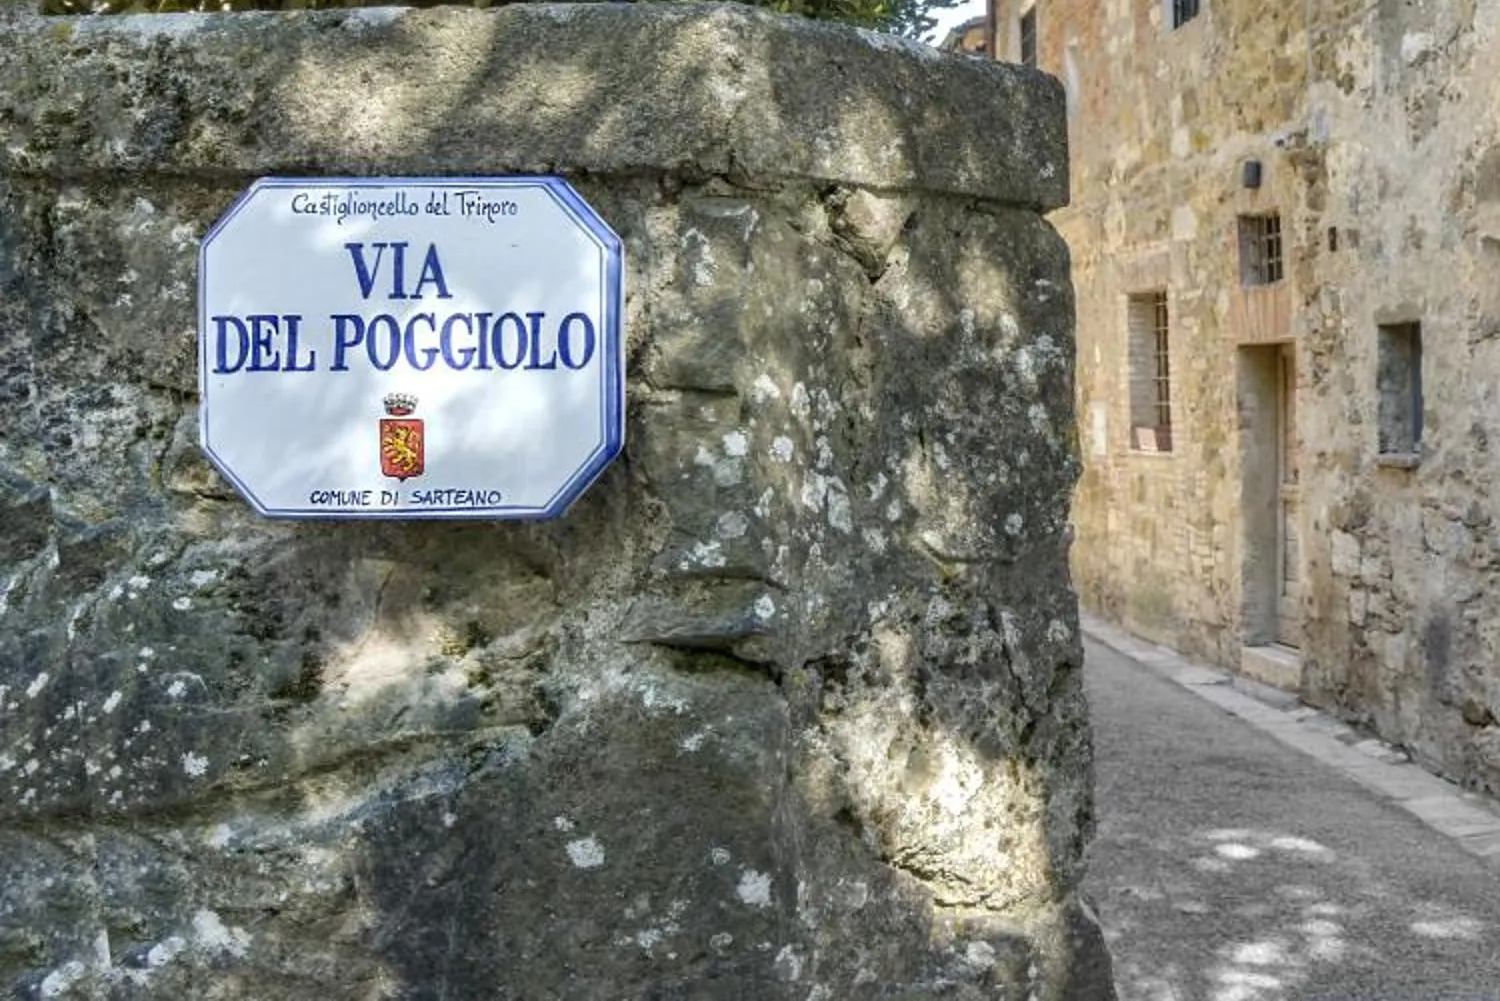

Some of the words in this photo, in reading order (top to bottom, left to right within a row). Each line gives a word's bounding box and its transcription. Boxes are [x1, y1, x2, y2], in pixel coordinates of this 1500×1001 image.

[291, 192, 419, 225] Castiglioncello
[425, 192, 451, 216] del
[454, 190, 518, 224] Trinoro
[345, 242, 453, 300] VIA
[211, 314, 317, 374] DEL
[330, 312, 596, 371] POGGIOLO
[310, 489, 371, 506] COMUNE
[380, 489, 399, 506] DI
[409, 488, 501, 506] SARTEANO
